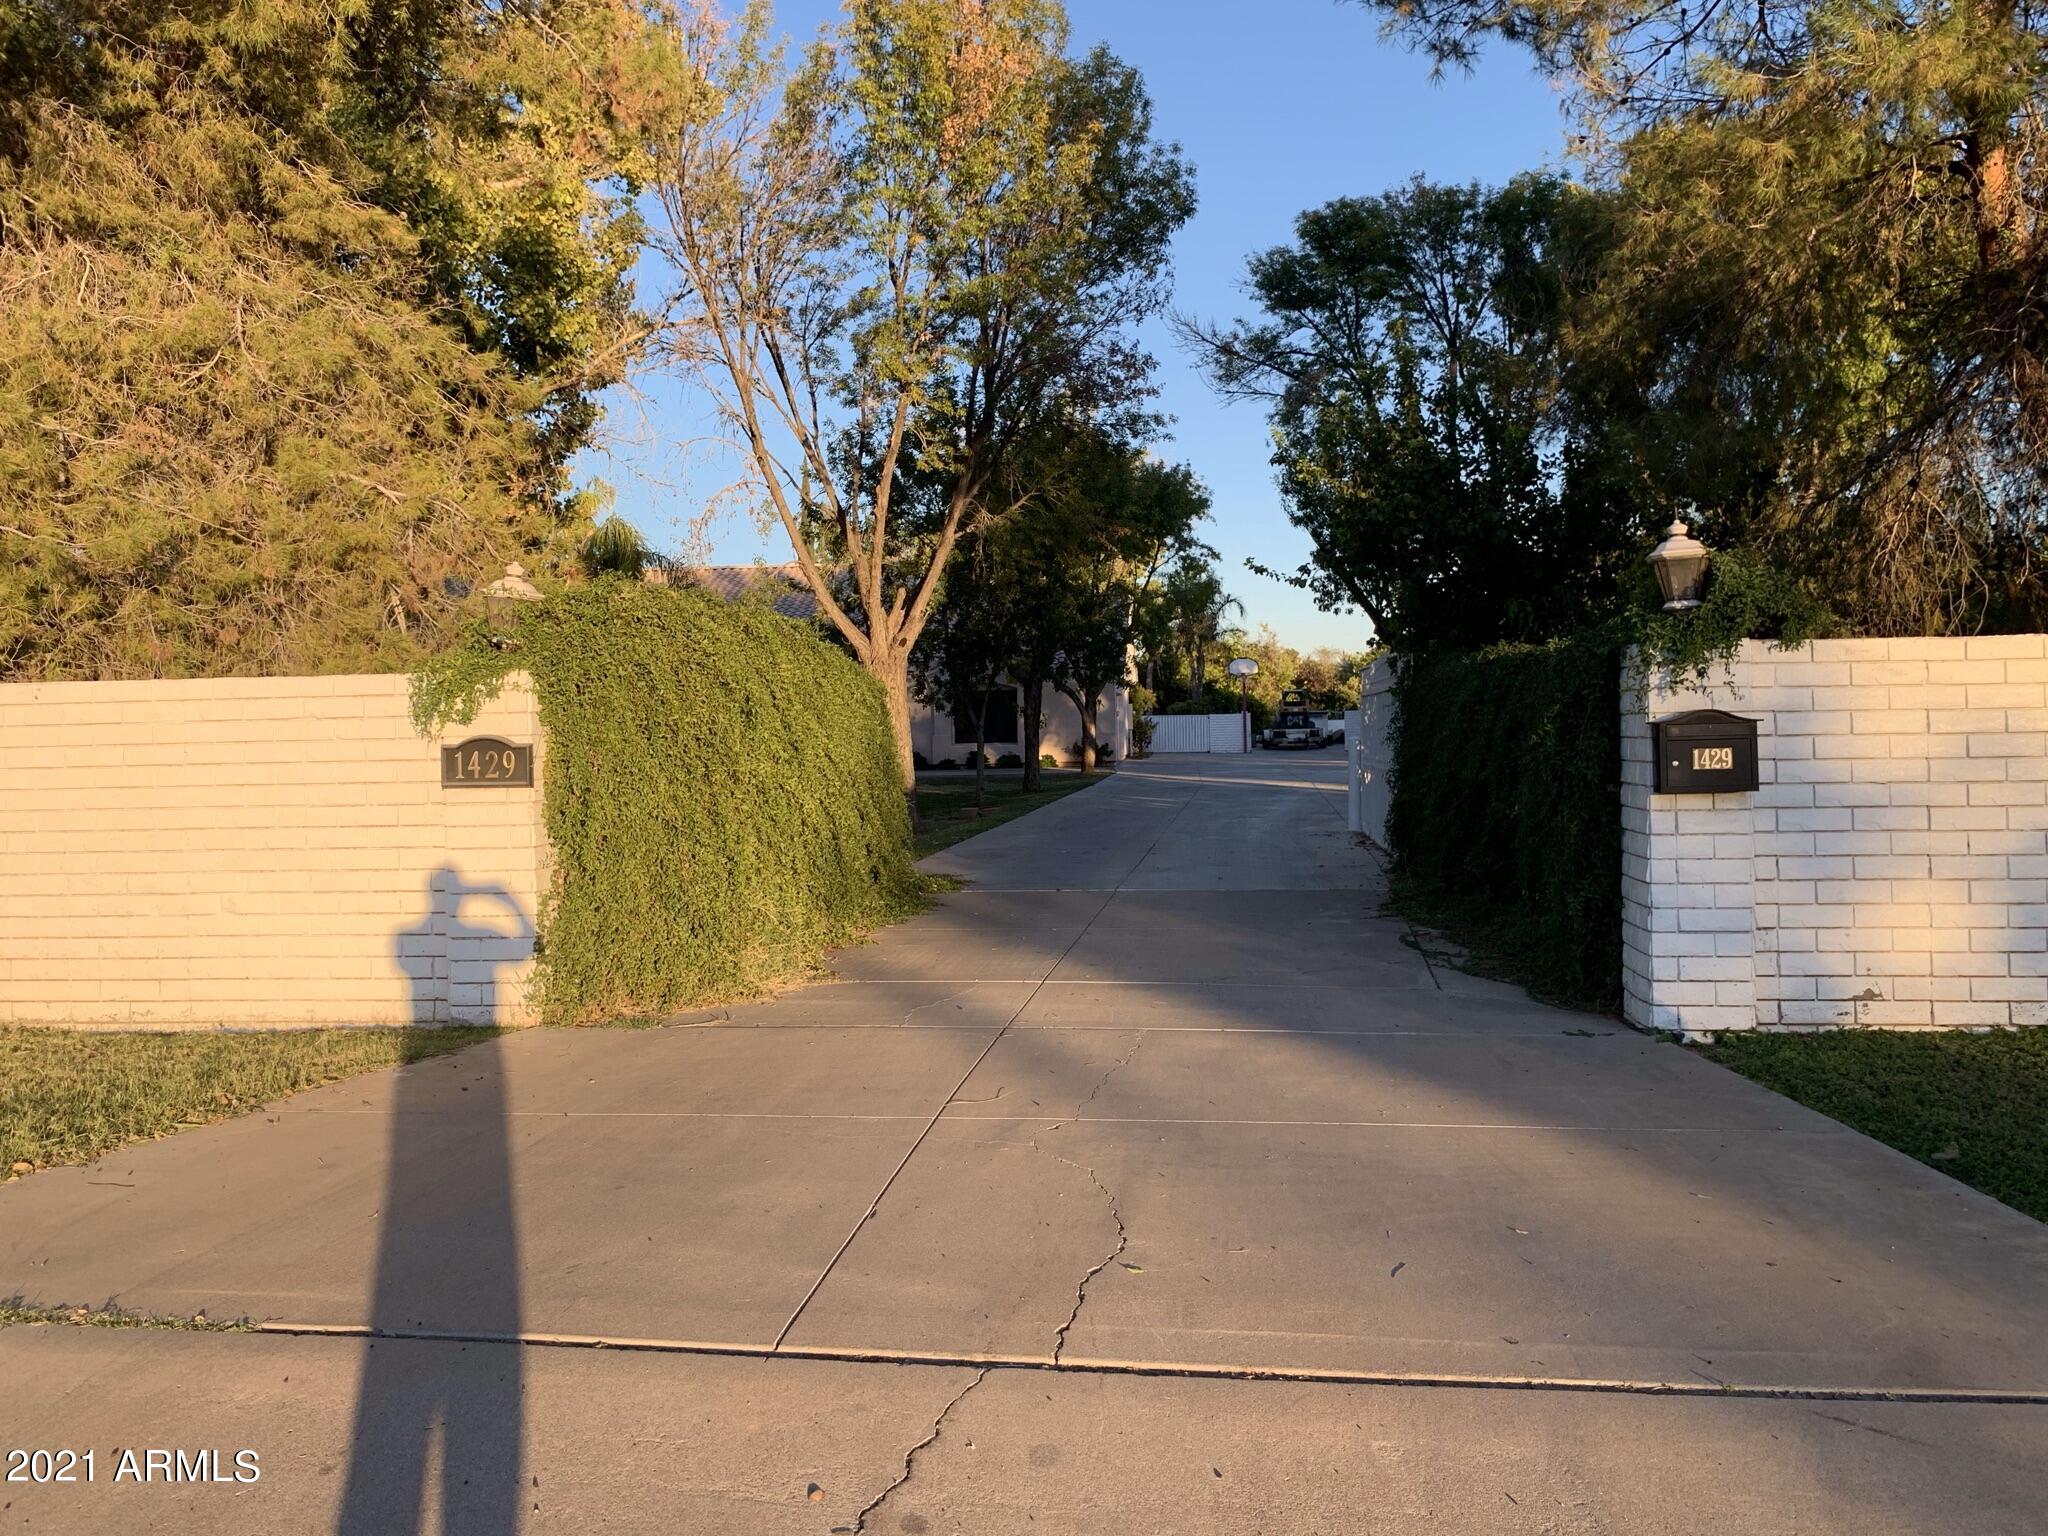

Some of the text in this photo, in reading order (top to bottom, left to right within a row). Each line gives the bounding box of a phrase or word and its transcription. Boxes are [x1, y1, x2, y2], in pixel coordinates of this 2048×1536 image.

[1287, 715, 1304, 726] CAT
[454, 751, 515, 779] 1429
[1693, 748, 1733, 769] 1429
